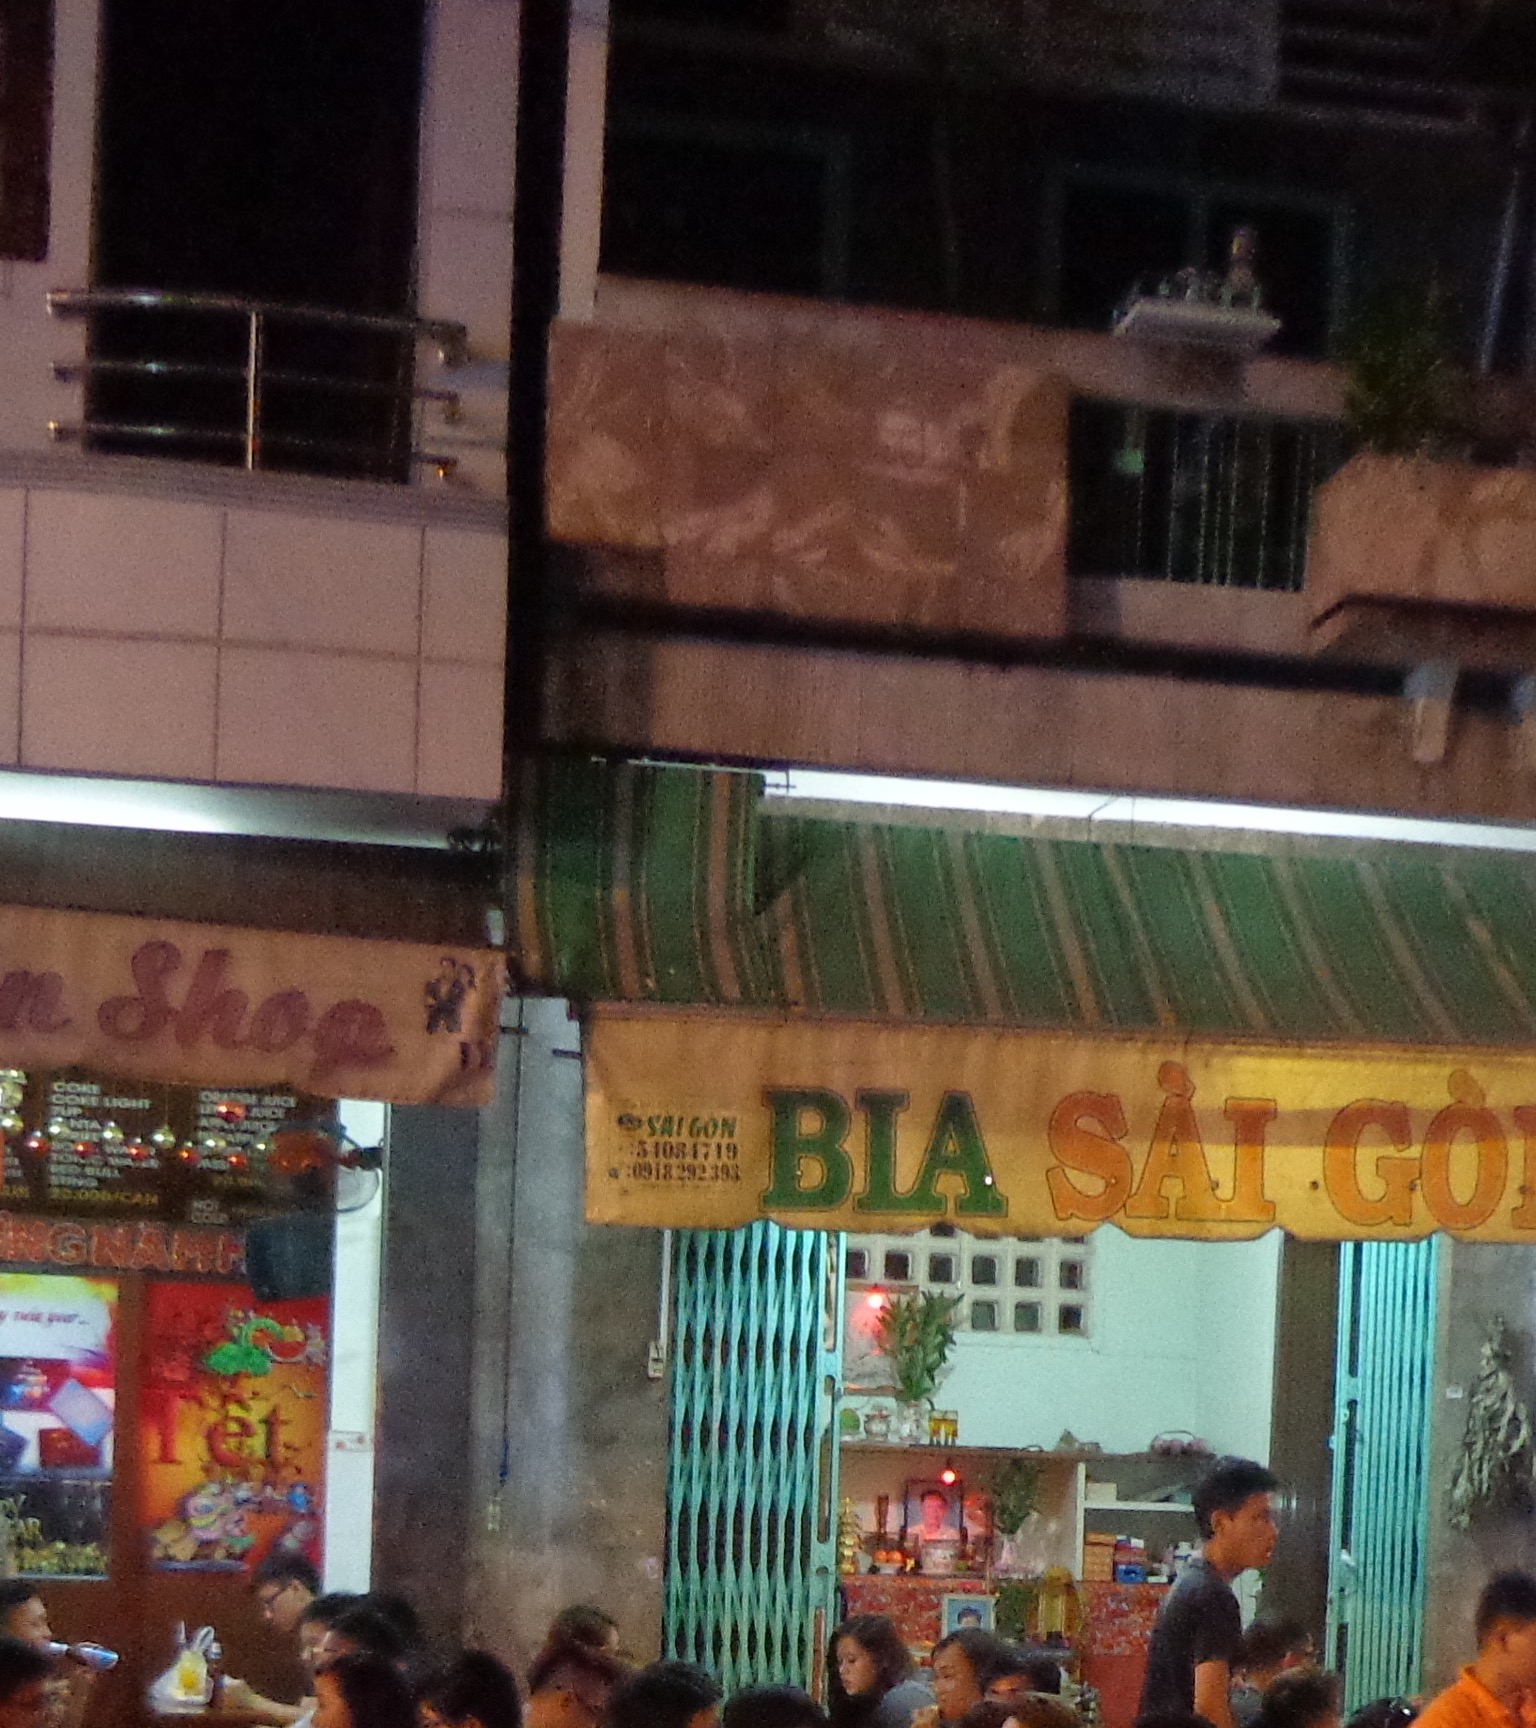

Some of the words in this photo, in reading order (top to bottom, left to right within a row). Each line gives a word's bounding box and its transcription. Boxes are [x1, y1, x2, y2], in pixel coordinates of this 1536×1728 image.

[99, 939, 396, 1077] Shop
[760, 1087, 1008, 1217] BIA
[1047, 1061, 1278, 1224] SÀI
